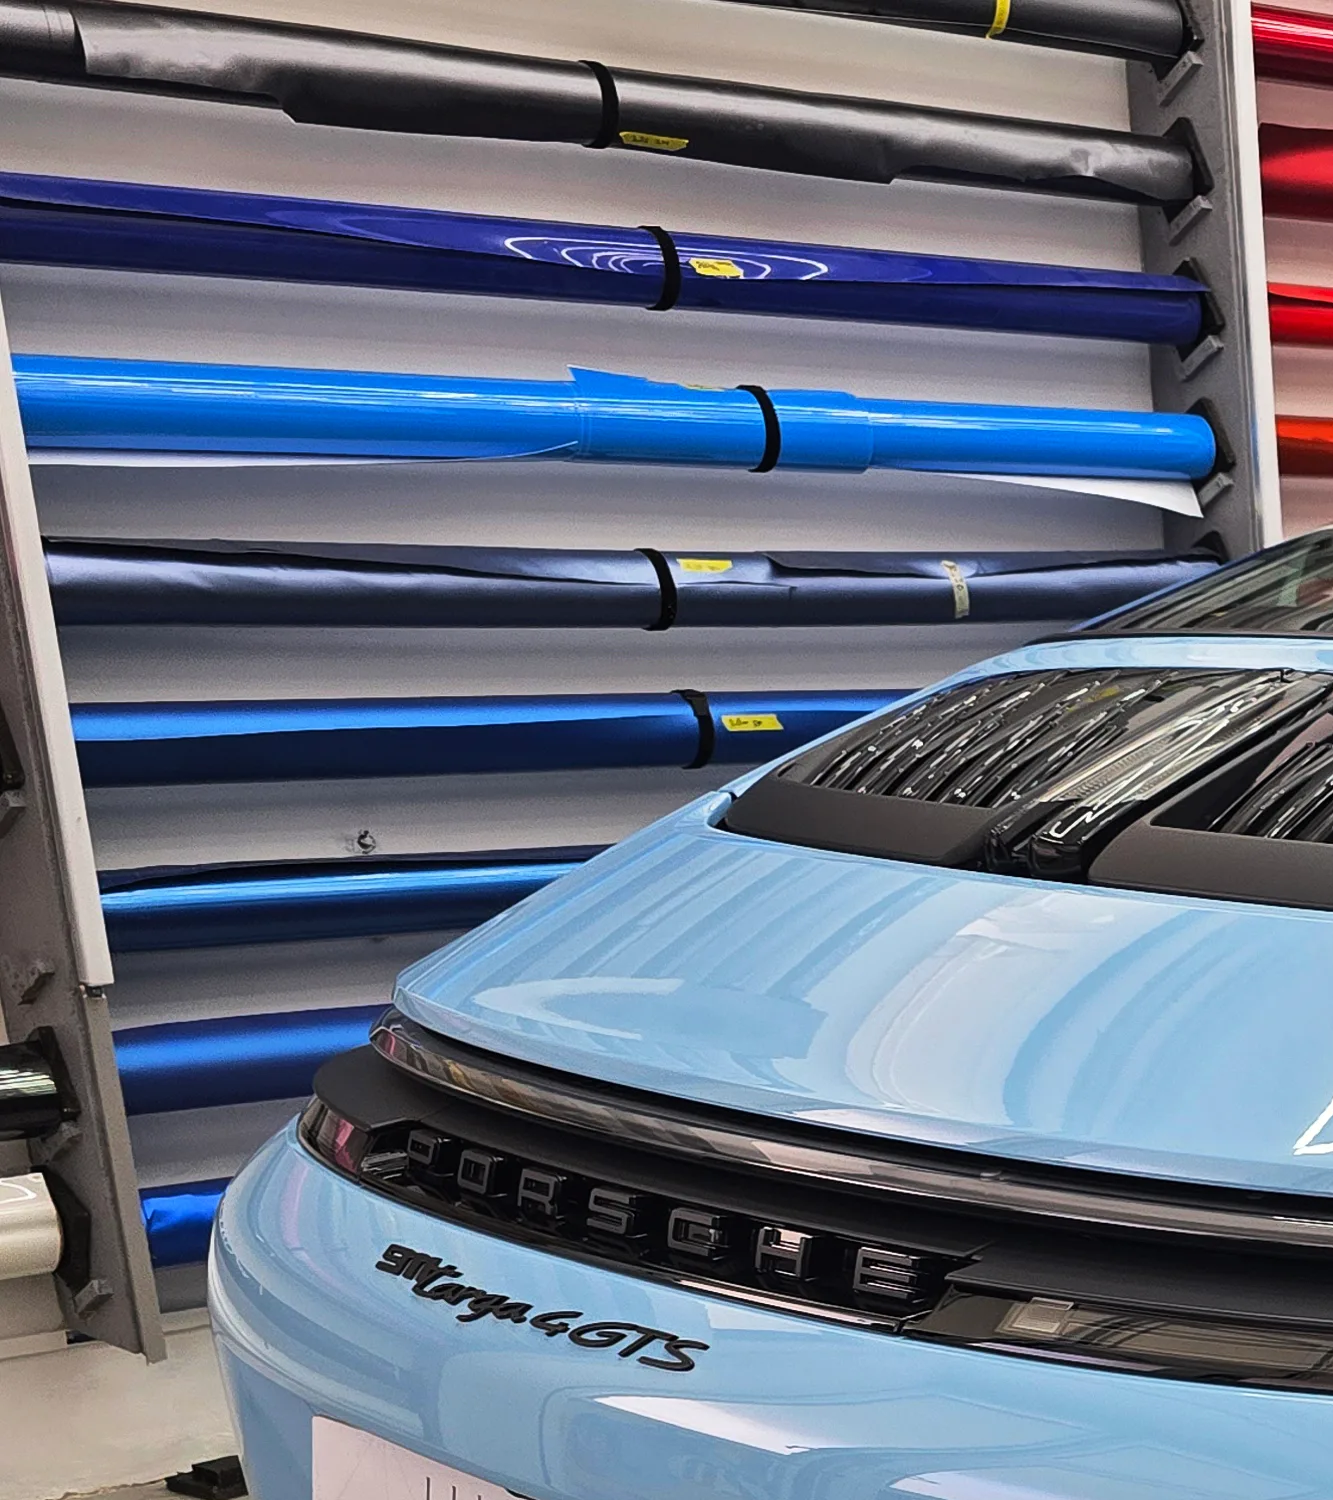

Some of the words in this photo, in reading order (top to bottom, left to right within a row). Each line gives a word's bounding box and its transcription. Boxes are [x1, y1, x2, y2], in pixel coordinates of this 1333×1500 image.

[407, 1128, 922, 1298] PORSCHE
[529, 1310, 584, 1338] 4
[568, 1320, 710, 1373] GTS
